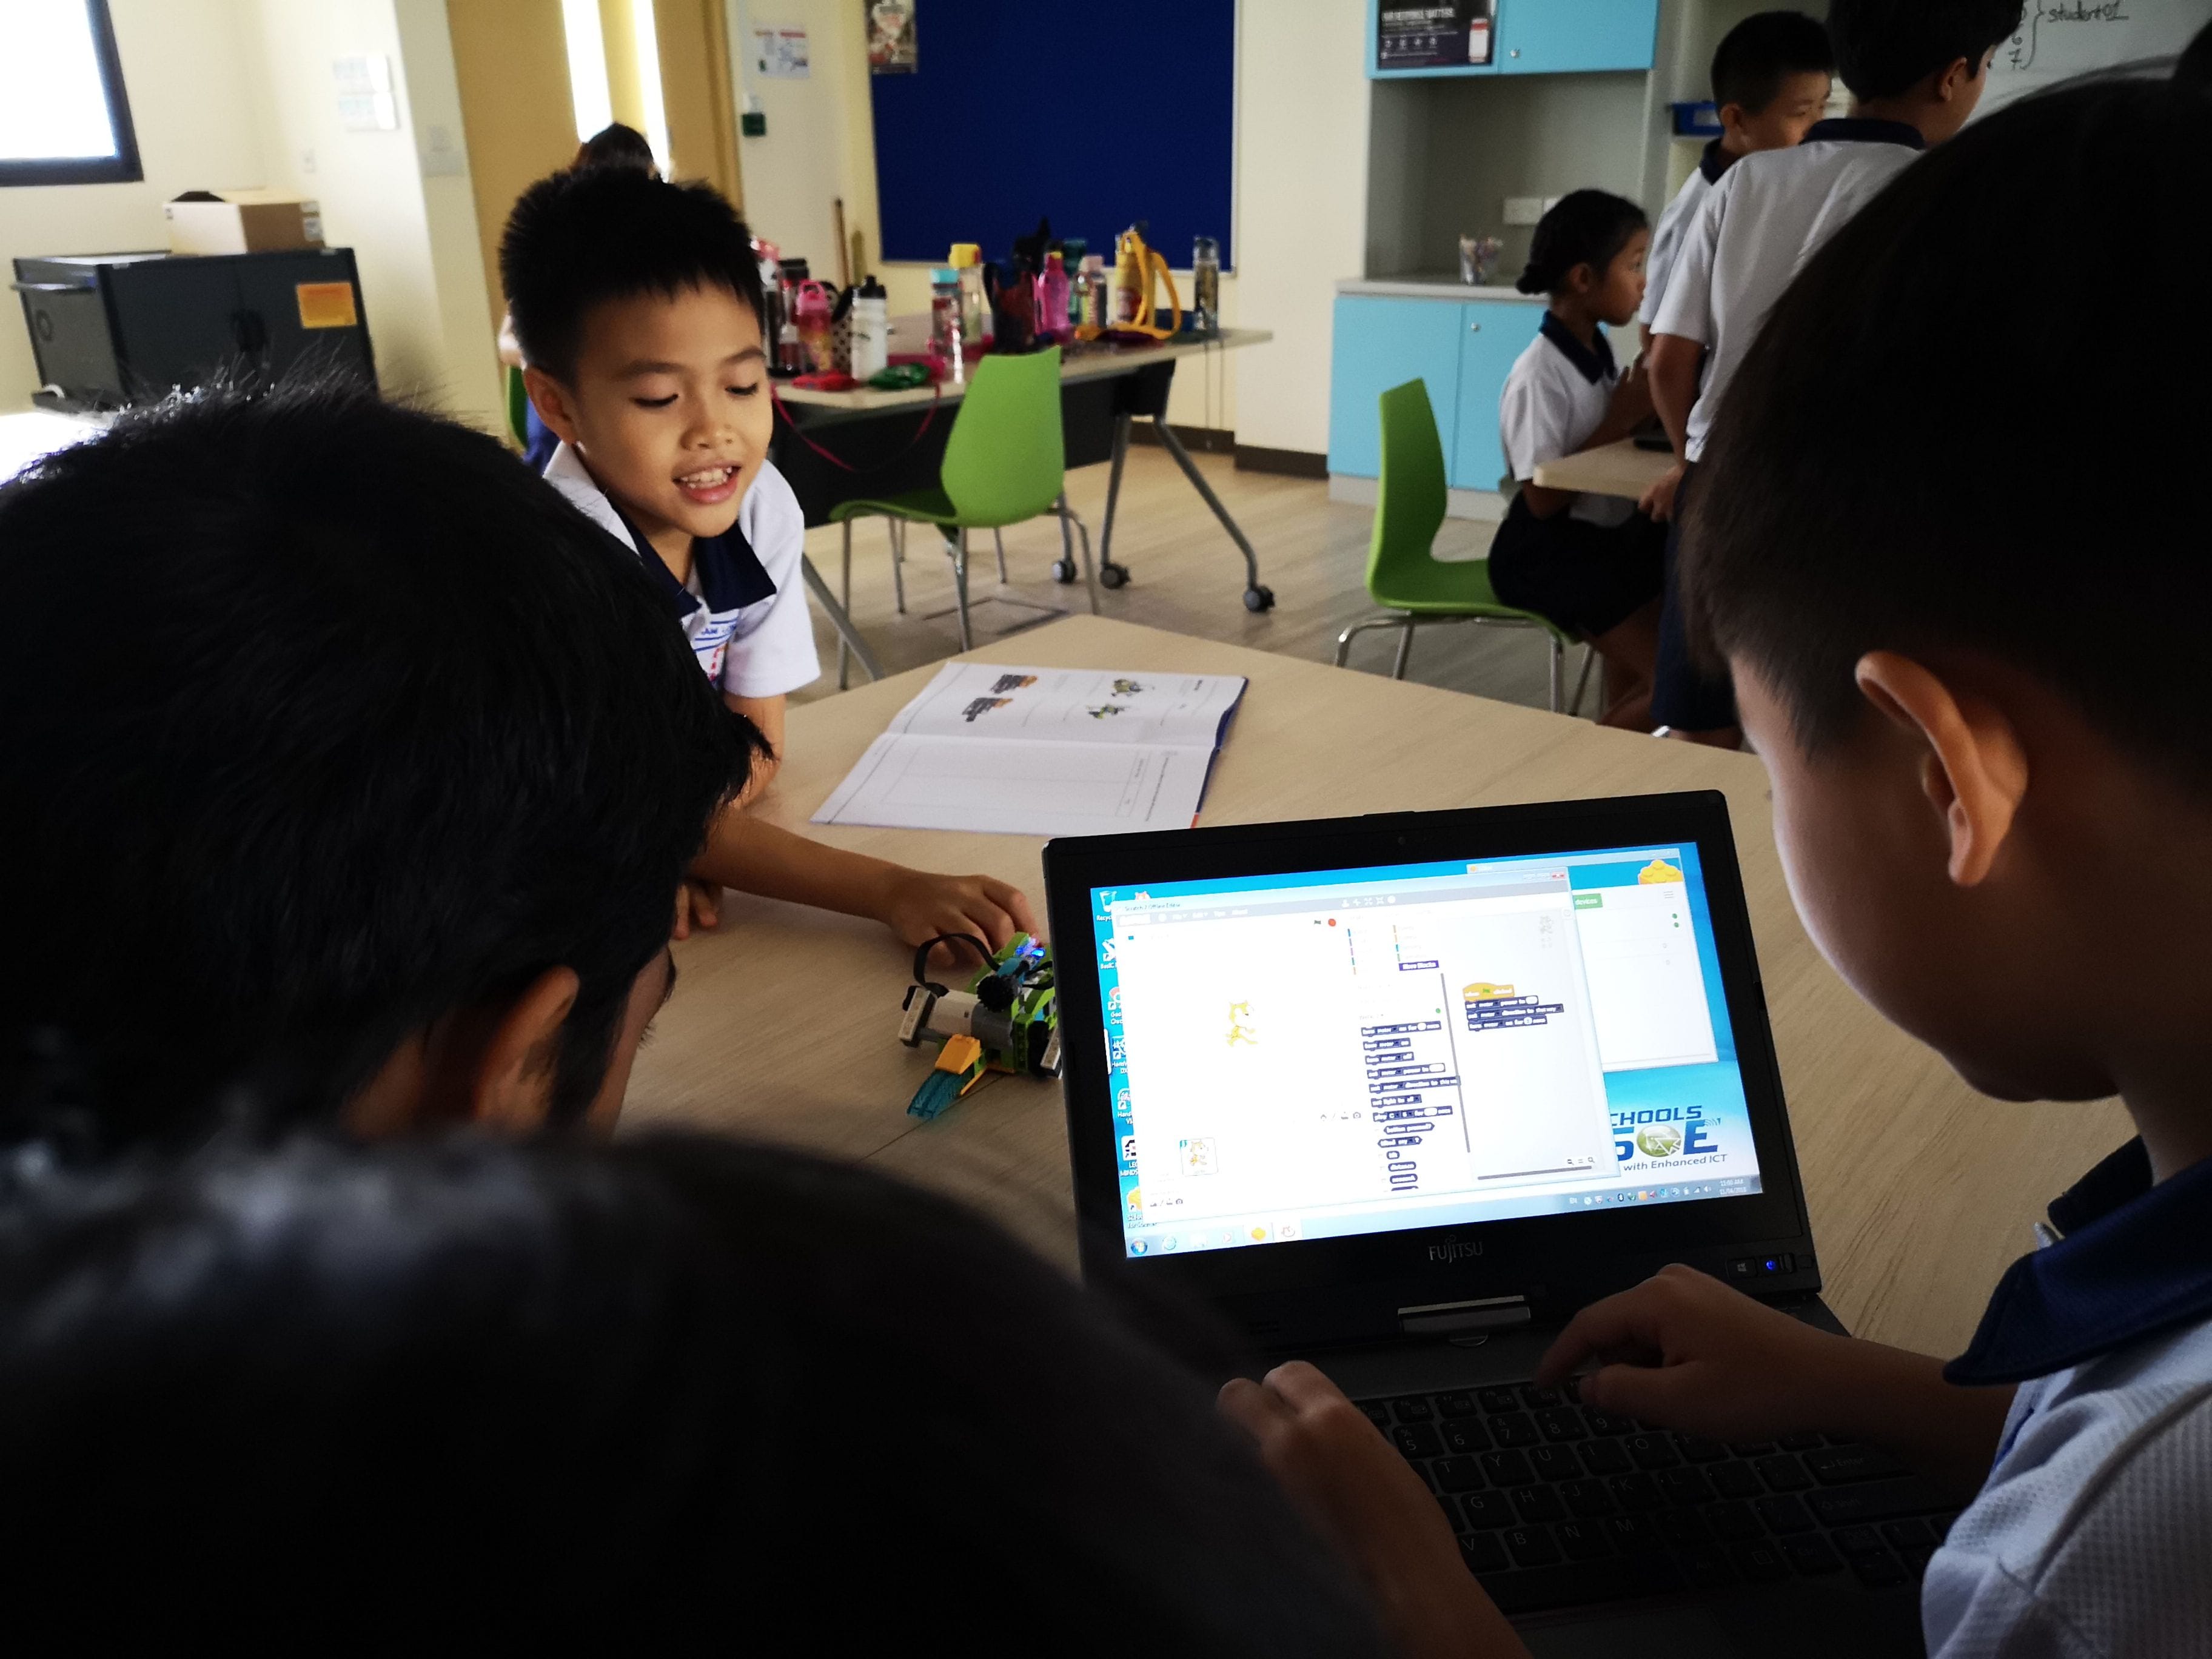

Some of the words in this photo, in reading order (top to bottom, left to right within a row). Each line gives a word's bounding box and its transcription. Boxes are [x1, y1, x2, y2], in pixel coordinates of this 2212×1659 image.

[1624, 1161, 1648, 1171] with
[1651, 1156, 1707, 1170] Enhanced
[1709, 1153, 1728, 1164] ICT
